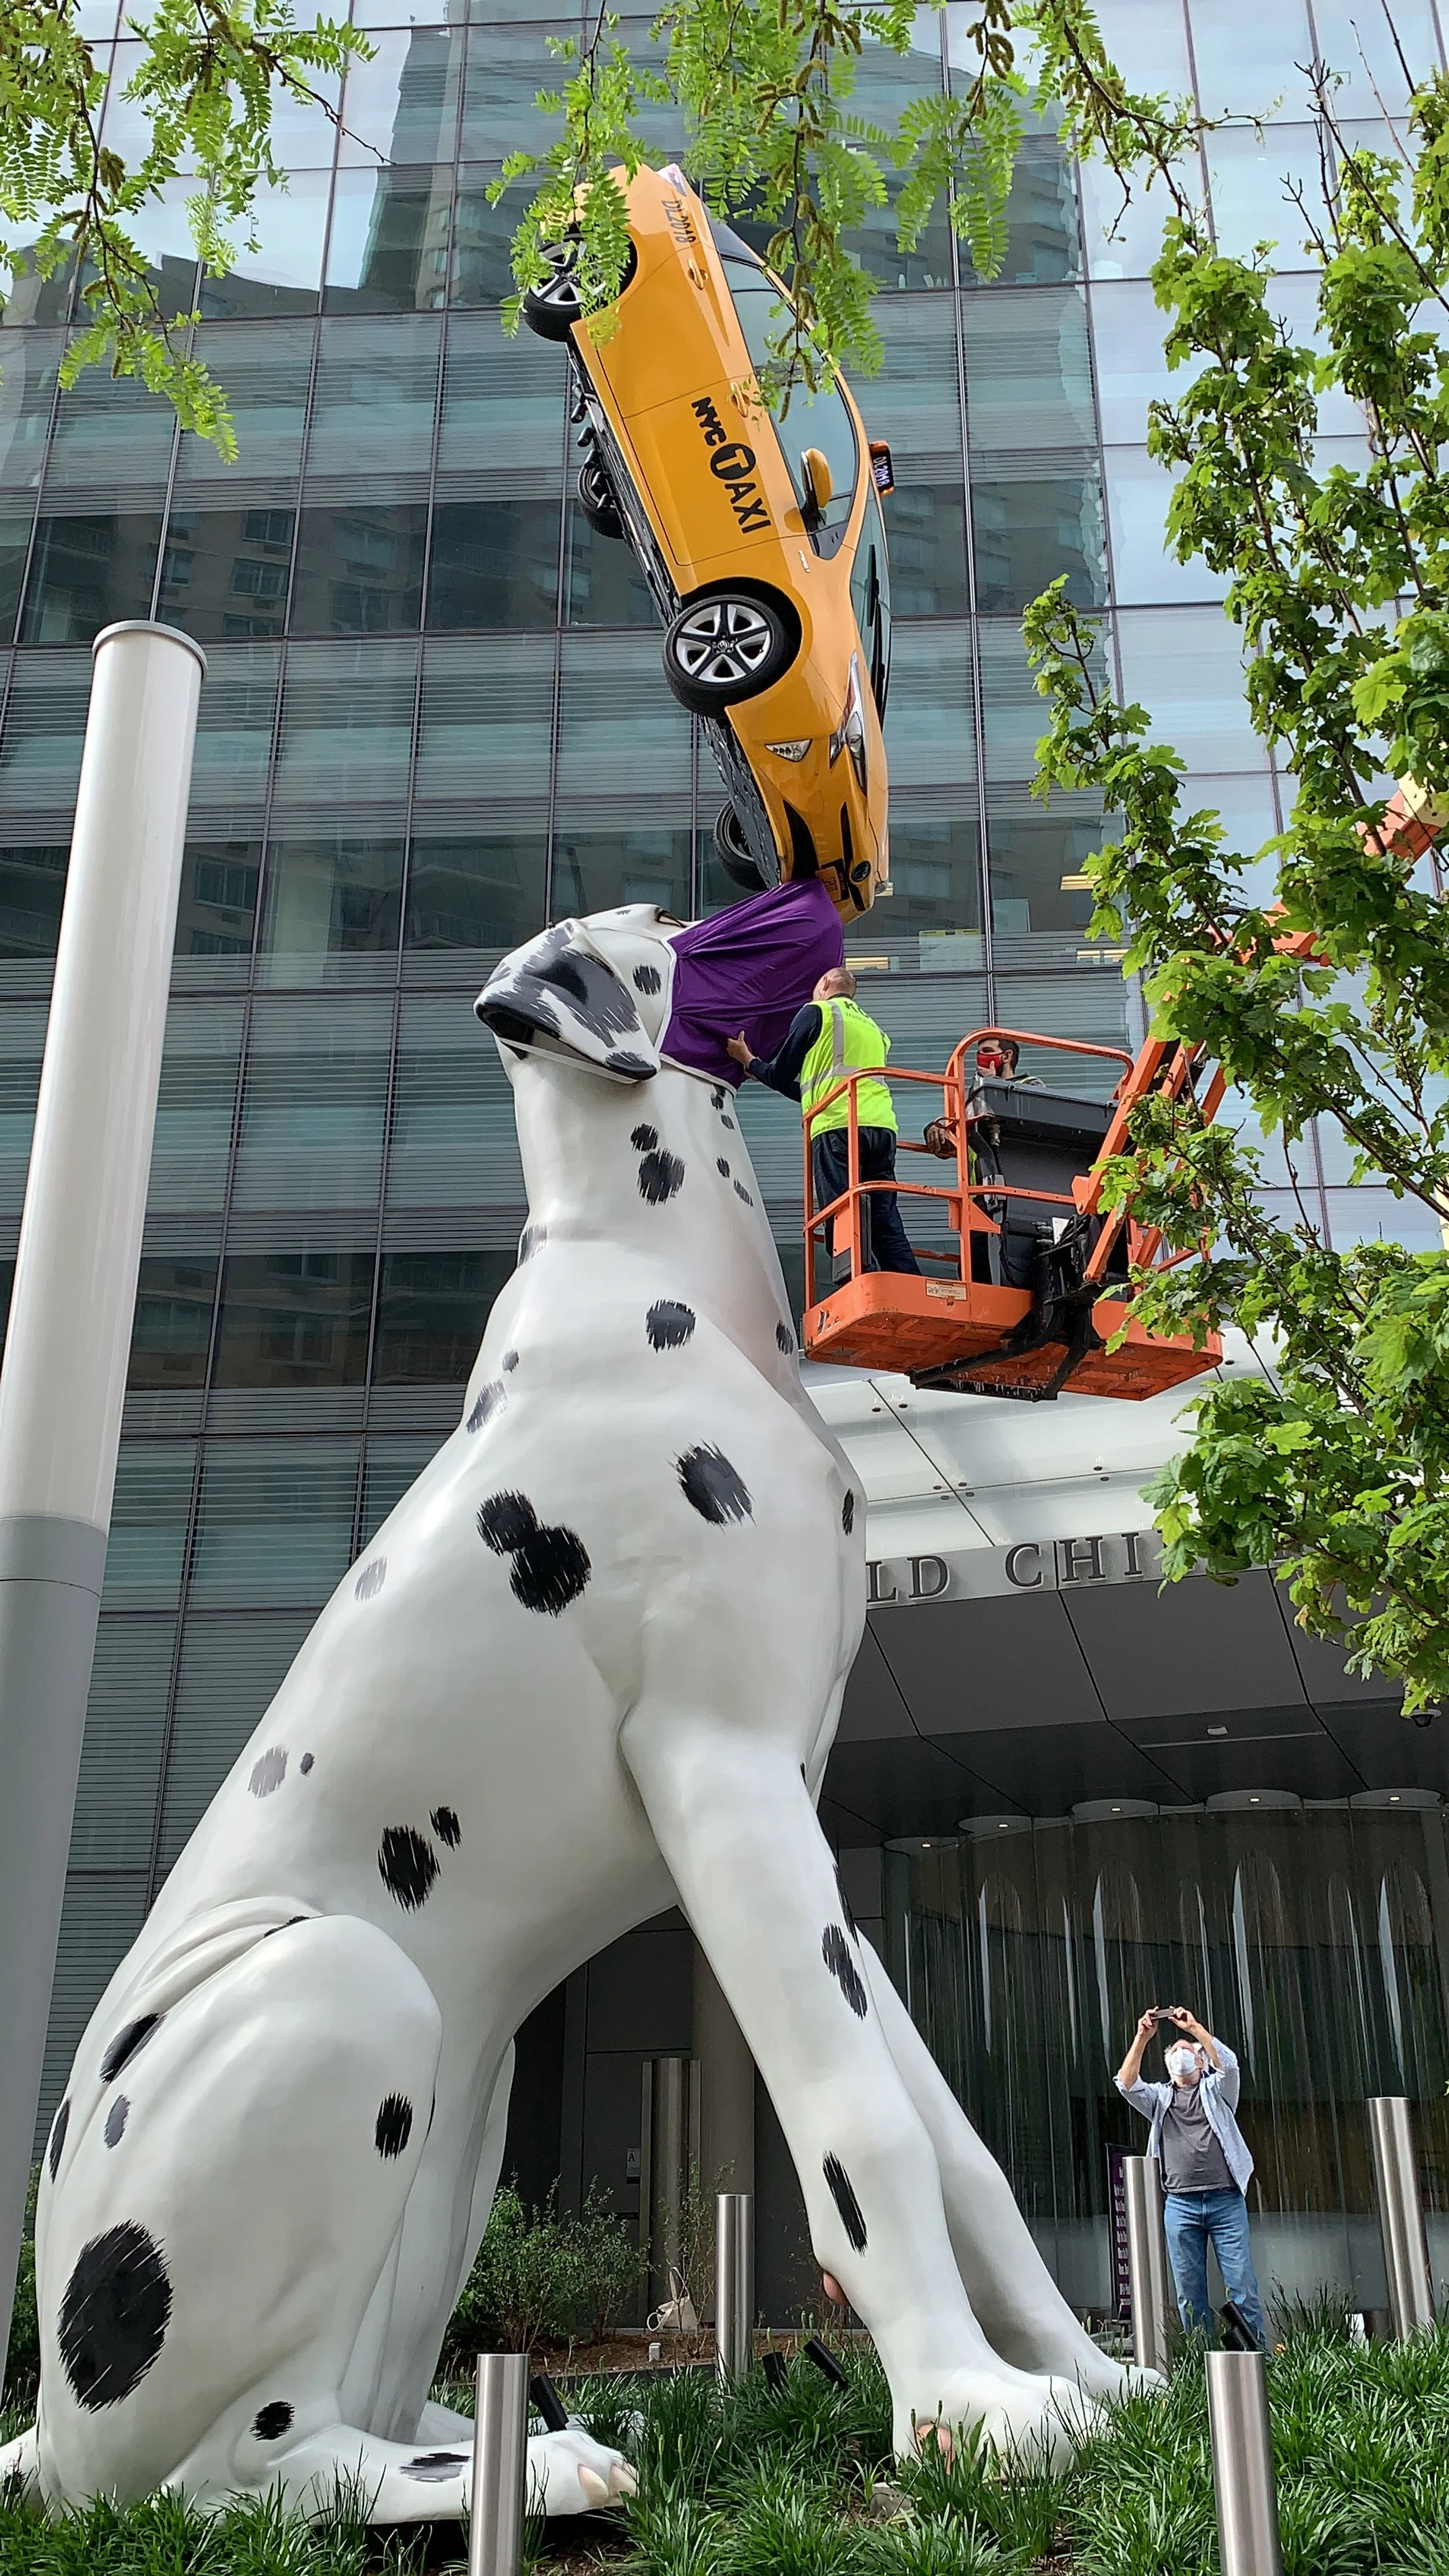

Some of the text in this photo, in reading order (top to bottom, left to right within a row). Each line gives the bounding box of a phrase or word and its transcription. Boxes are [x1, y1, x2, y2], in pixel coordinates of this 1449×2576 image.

[661, 199, 697, 243] DL2018
[691, 396, 771, 534] NYC TAXI
[873, 456, 890, 487] DL2018
[1005, 1532, 1164, 1587] CHI
